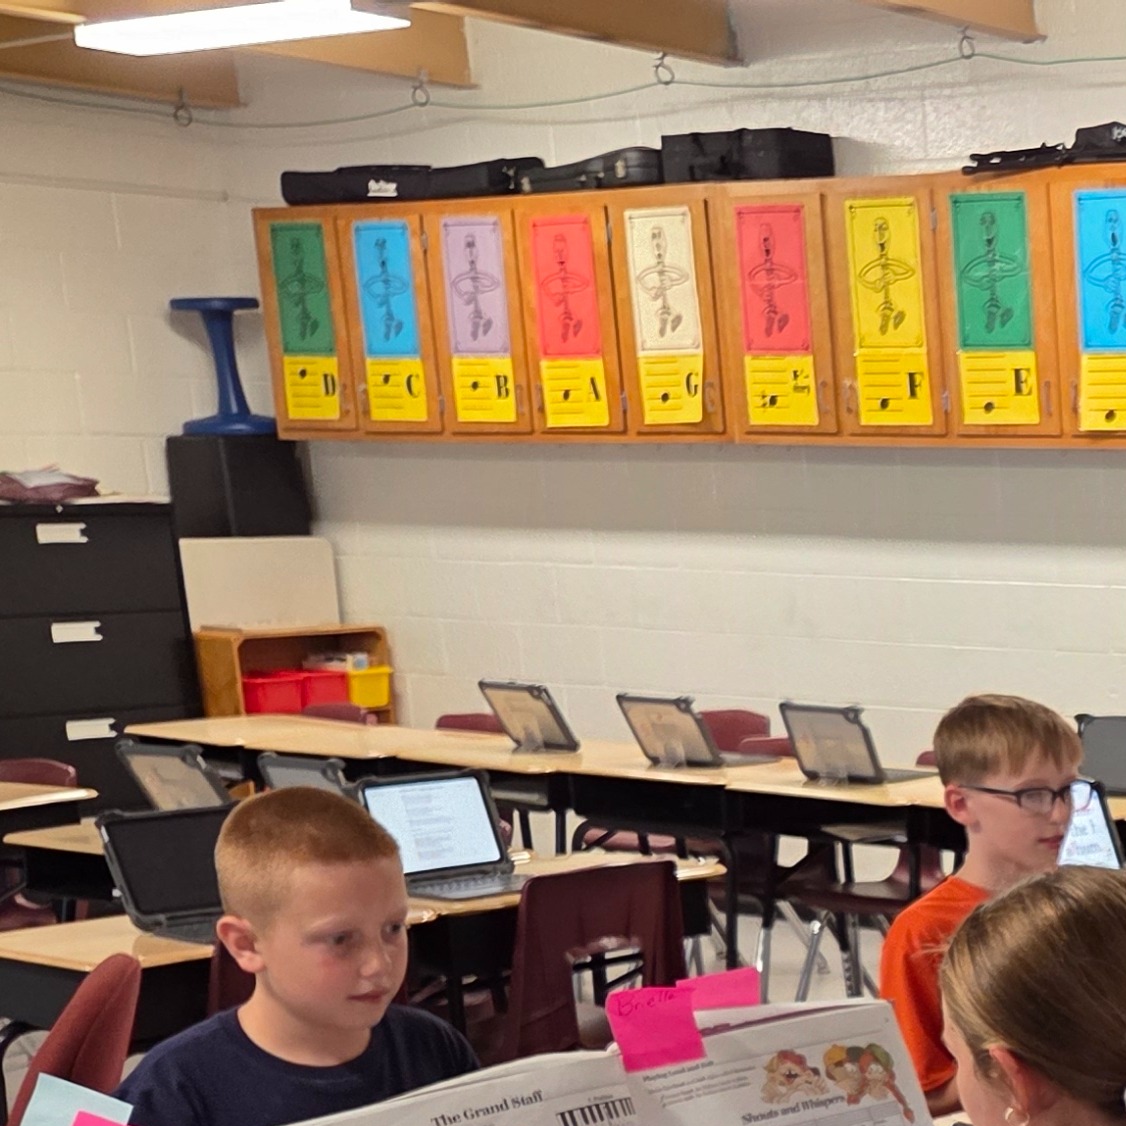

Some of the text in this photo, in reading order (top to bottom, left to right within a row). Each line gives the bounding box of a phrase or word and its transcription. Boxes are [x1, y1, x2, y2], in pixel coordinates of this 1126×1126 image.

[323, 373, 337, 397] D
[406, 374, 420, 398] C
[496, 375, 510, 399] B
[588, 377, 601, 402] A
[686, 372, 699, 398] G
[906, 371, 924, 398] F
[1013, 368, 1033, 395] E
[463, 1099, 510, 1121] Grand
[511, 1089, 544, 1110] Staff
[741, 1093, 846, 1125] Shouts and Whispers
